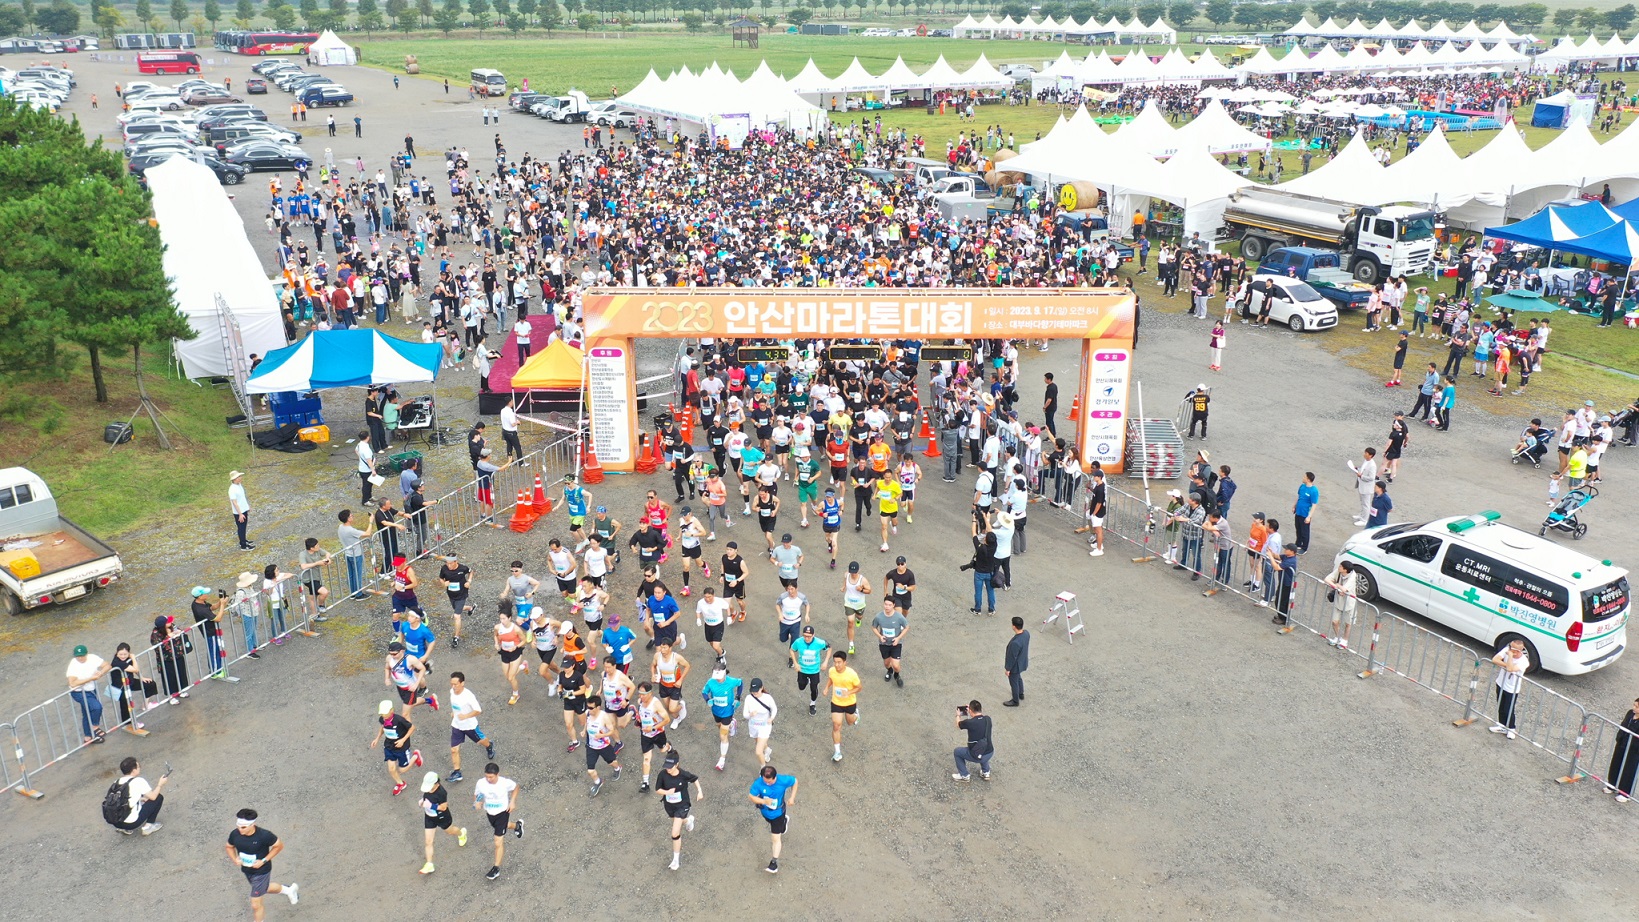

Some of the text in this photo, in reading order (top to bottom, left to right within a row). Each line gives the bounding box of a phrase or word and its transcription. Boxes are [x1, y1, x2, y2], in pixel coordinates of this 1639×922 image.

[641, 301, 973, 335] 2023 안산마라톤대회
[988, 306, 1004, 316] 일시
[1463, 557, 1491, 574] CT.MRI
[1522, 591, 1557, 611] 1644-0800
[1510, 605, 1557, 631] 박진영병원
